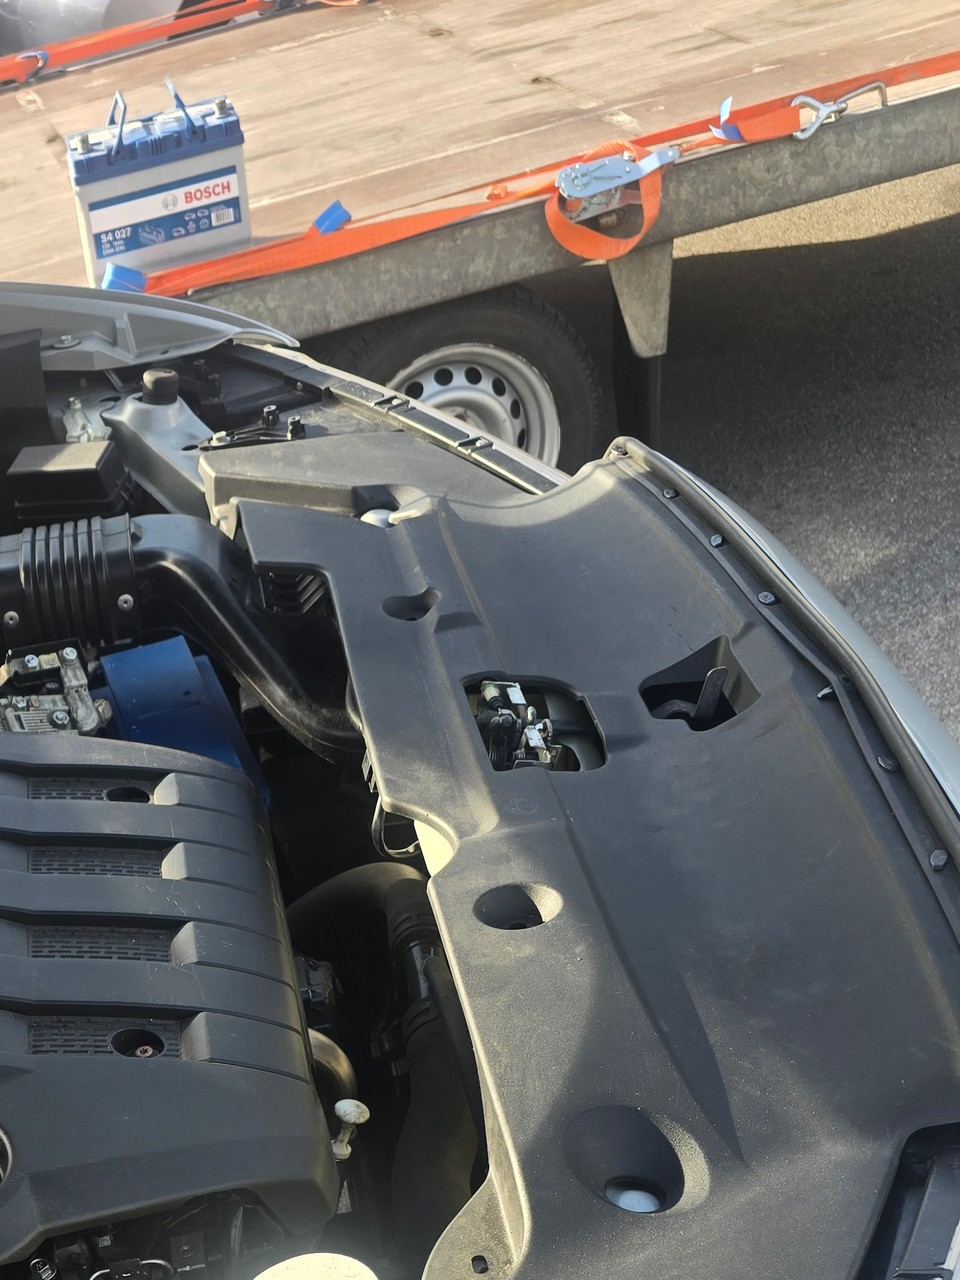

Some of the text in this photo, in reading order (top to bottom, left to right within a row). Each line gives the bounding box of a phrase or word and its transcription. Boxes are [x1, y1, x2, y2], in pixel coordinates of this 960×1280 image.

[184, 181, 231, 204] BOSCH
[101, 227, 131, 243] S4 027
